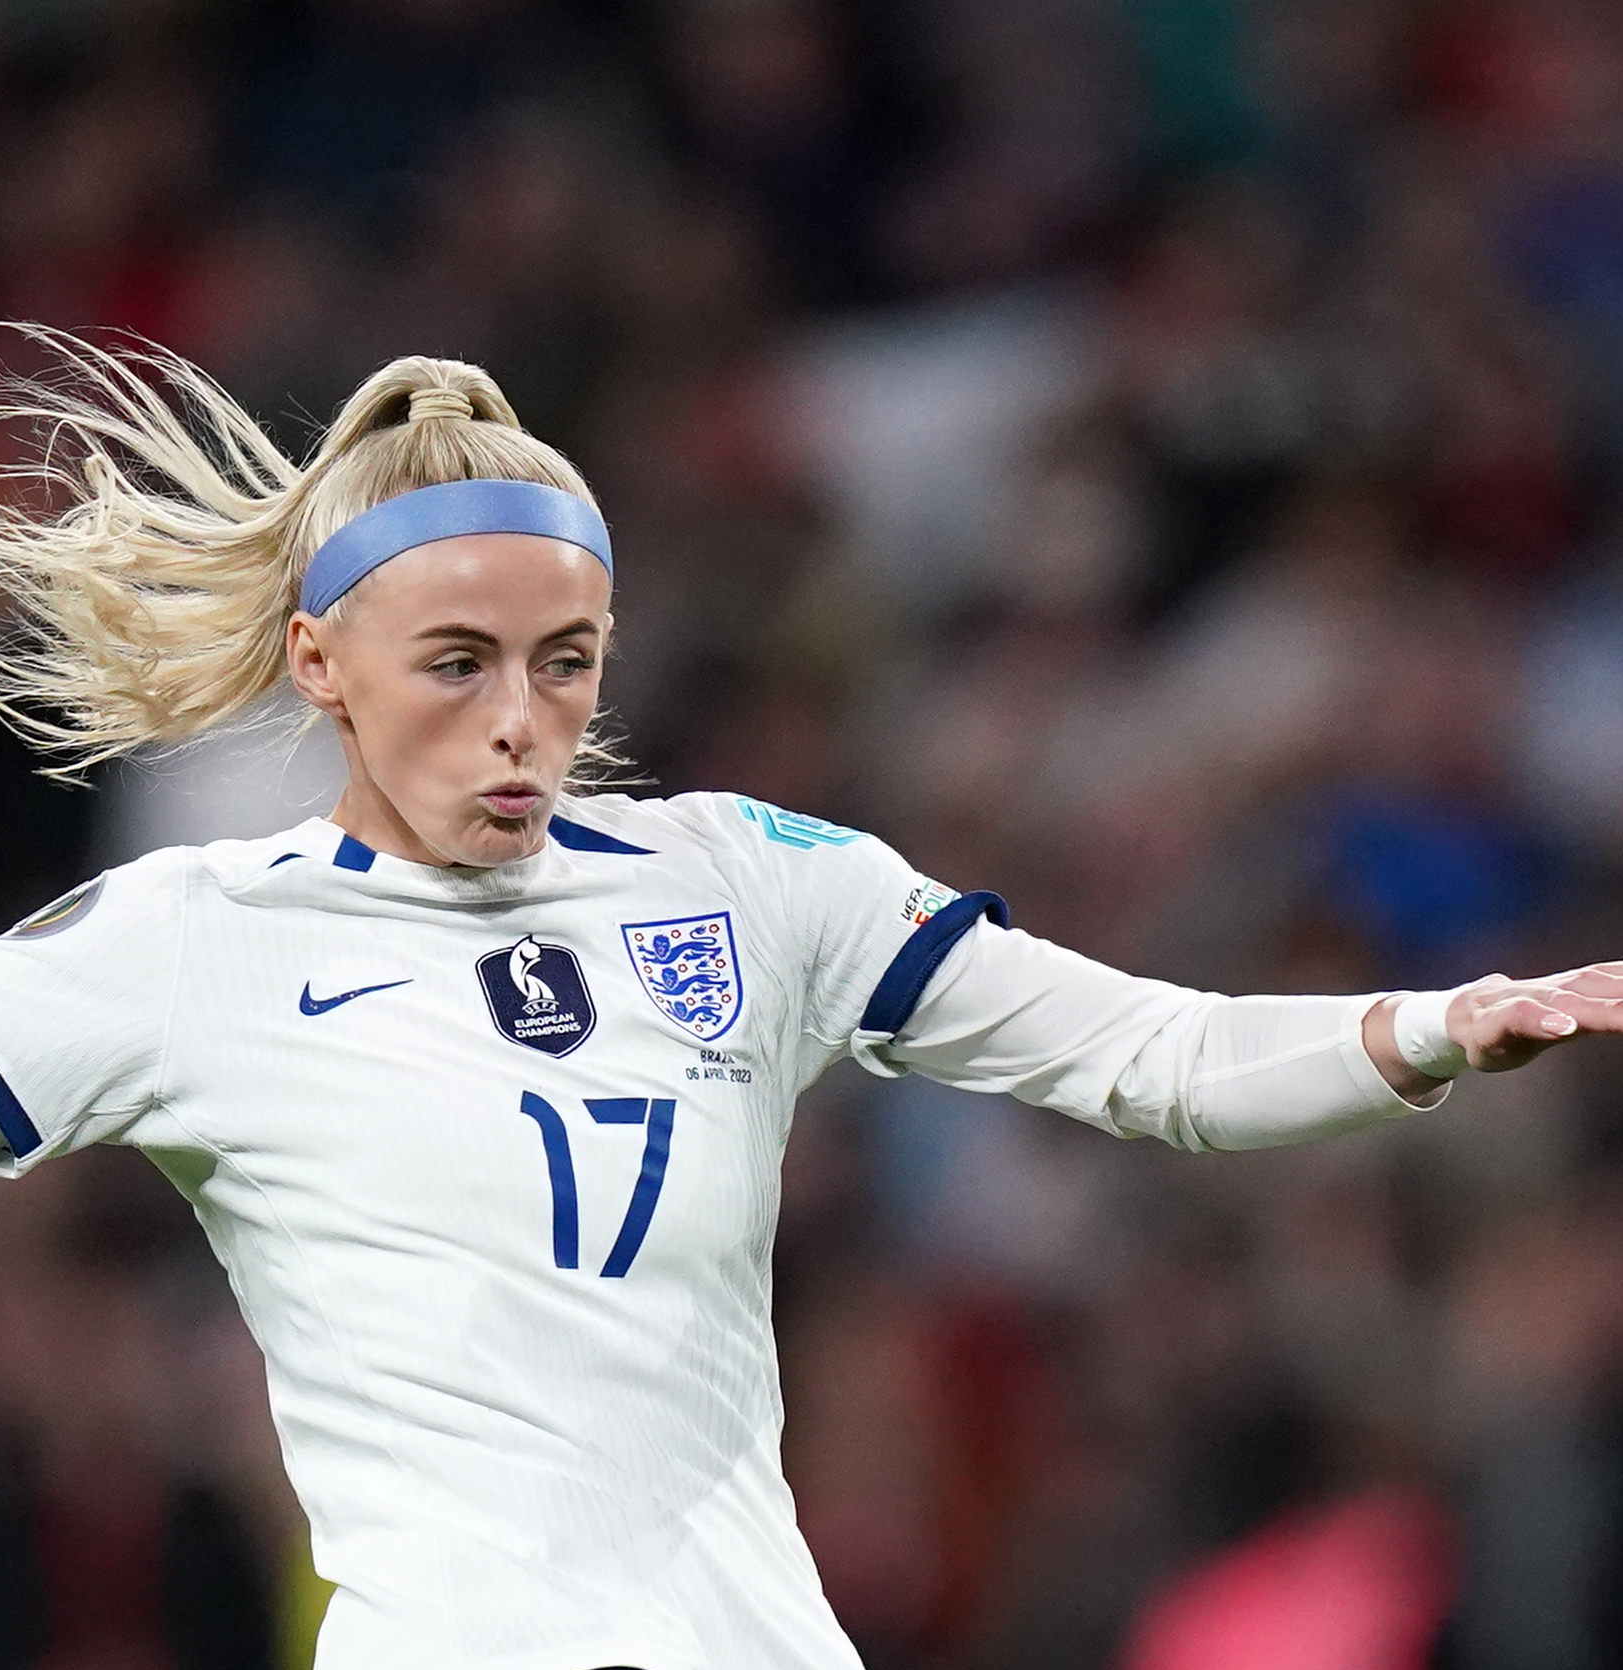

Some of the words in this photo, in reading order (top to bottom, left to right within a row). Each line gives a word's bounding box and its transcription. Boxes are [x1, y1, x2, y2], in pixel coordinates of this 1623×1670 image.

[900, 888, 924, 921] UEFA
[524, 1002, 557, 1014] UEFA
[514, 1012, 575, 1028] EUROPEAN
[514, 1022, 582, 1038] CHAMPIONS
[685, 1067, 700, 1080] 06
[729, 1069, 752, 1083] 2023
[520, 1090, 677, 1279] 17
